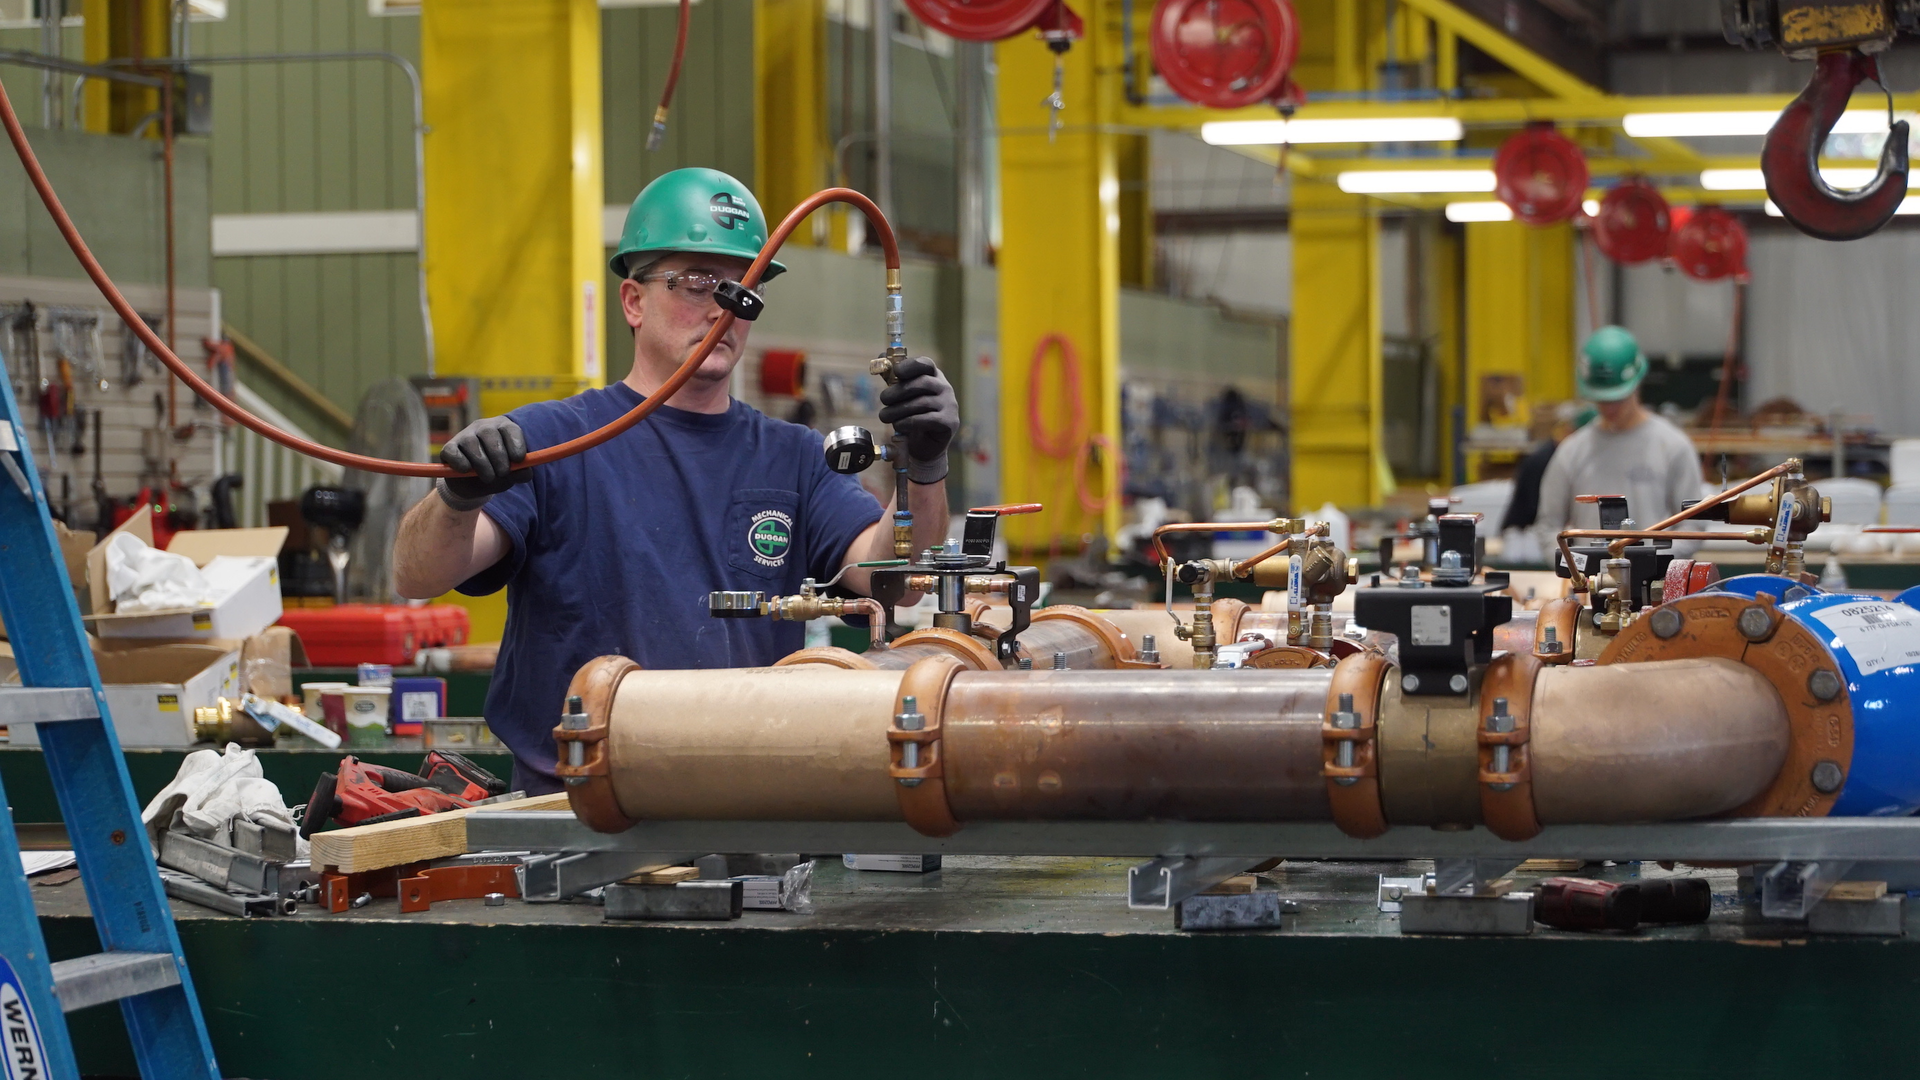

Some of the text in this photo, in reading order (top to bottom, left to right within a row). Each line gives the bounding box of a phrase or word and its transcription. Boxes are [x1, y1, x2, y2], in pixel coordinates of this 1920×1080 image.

[710, 205, 749, 219] DUGGAN
[751, 510, 793, 527] MECHANICAL
[754, 533, 789, 543] DUGGAN
[753, 555, 785, 567] SERVICES
[1841, 605, 1894, 617] 0825214
